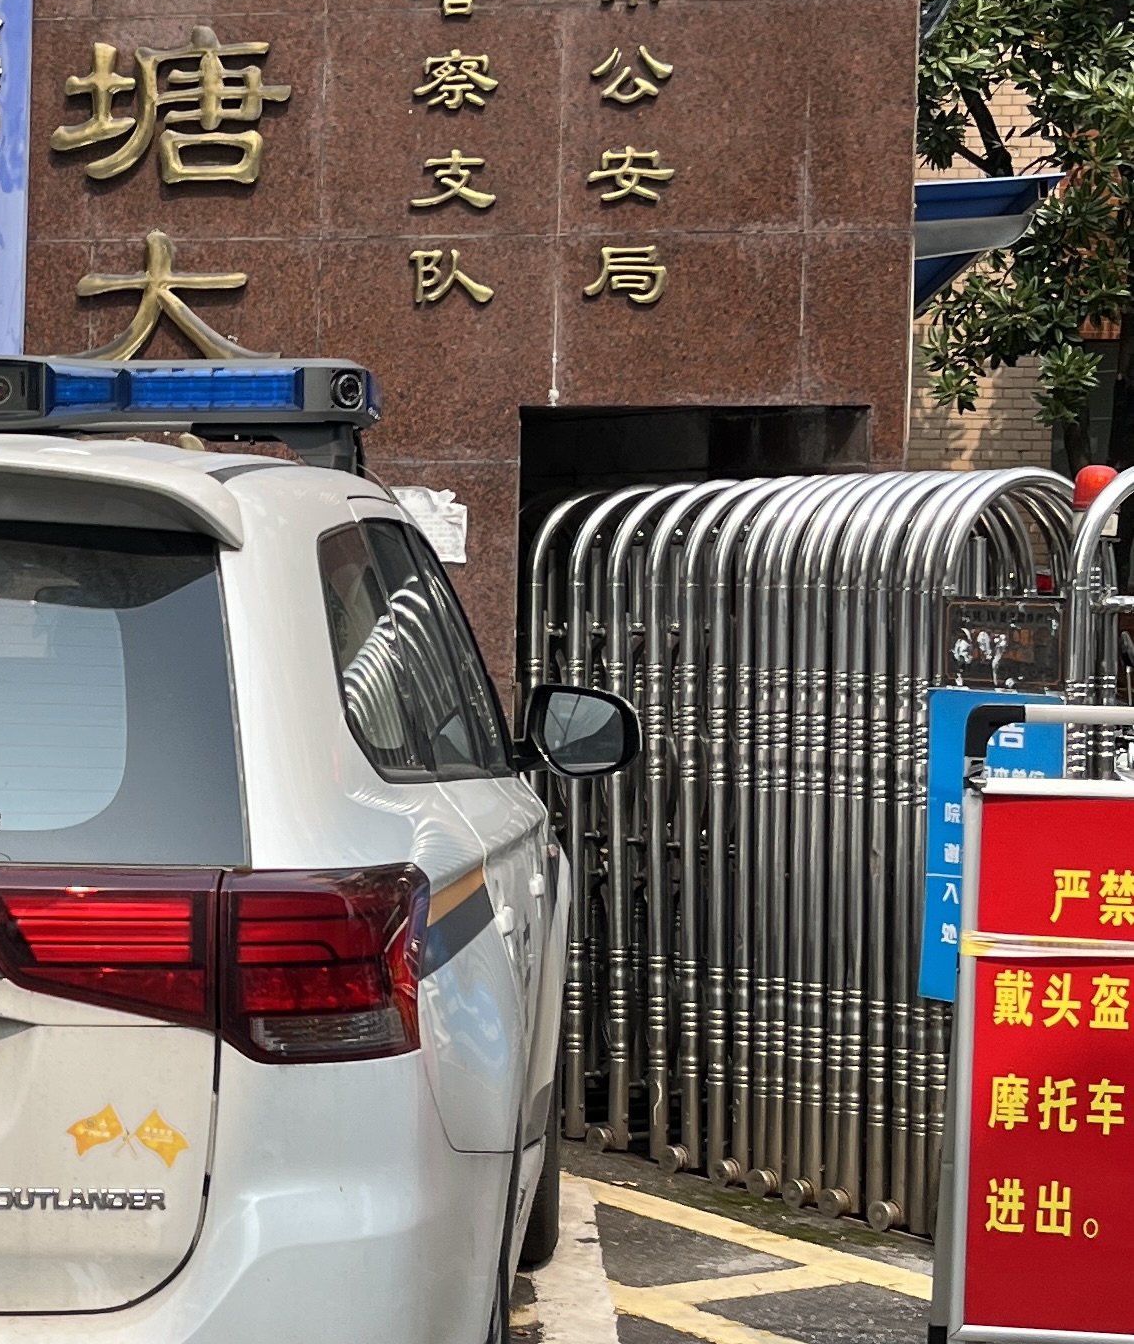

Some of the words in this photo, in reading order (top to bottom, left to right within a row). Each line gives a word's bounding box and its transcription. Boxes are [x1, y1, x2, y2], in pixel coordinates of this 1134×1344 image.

[1049, 869, 1134, 926] 严禁
[993, 969, 1130, 1030] 戴头盔
[988, 1073, 1125, 1136] 摩托车
[985, 1178, 1099, 1239] 进出。
